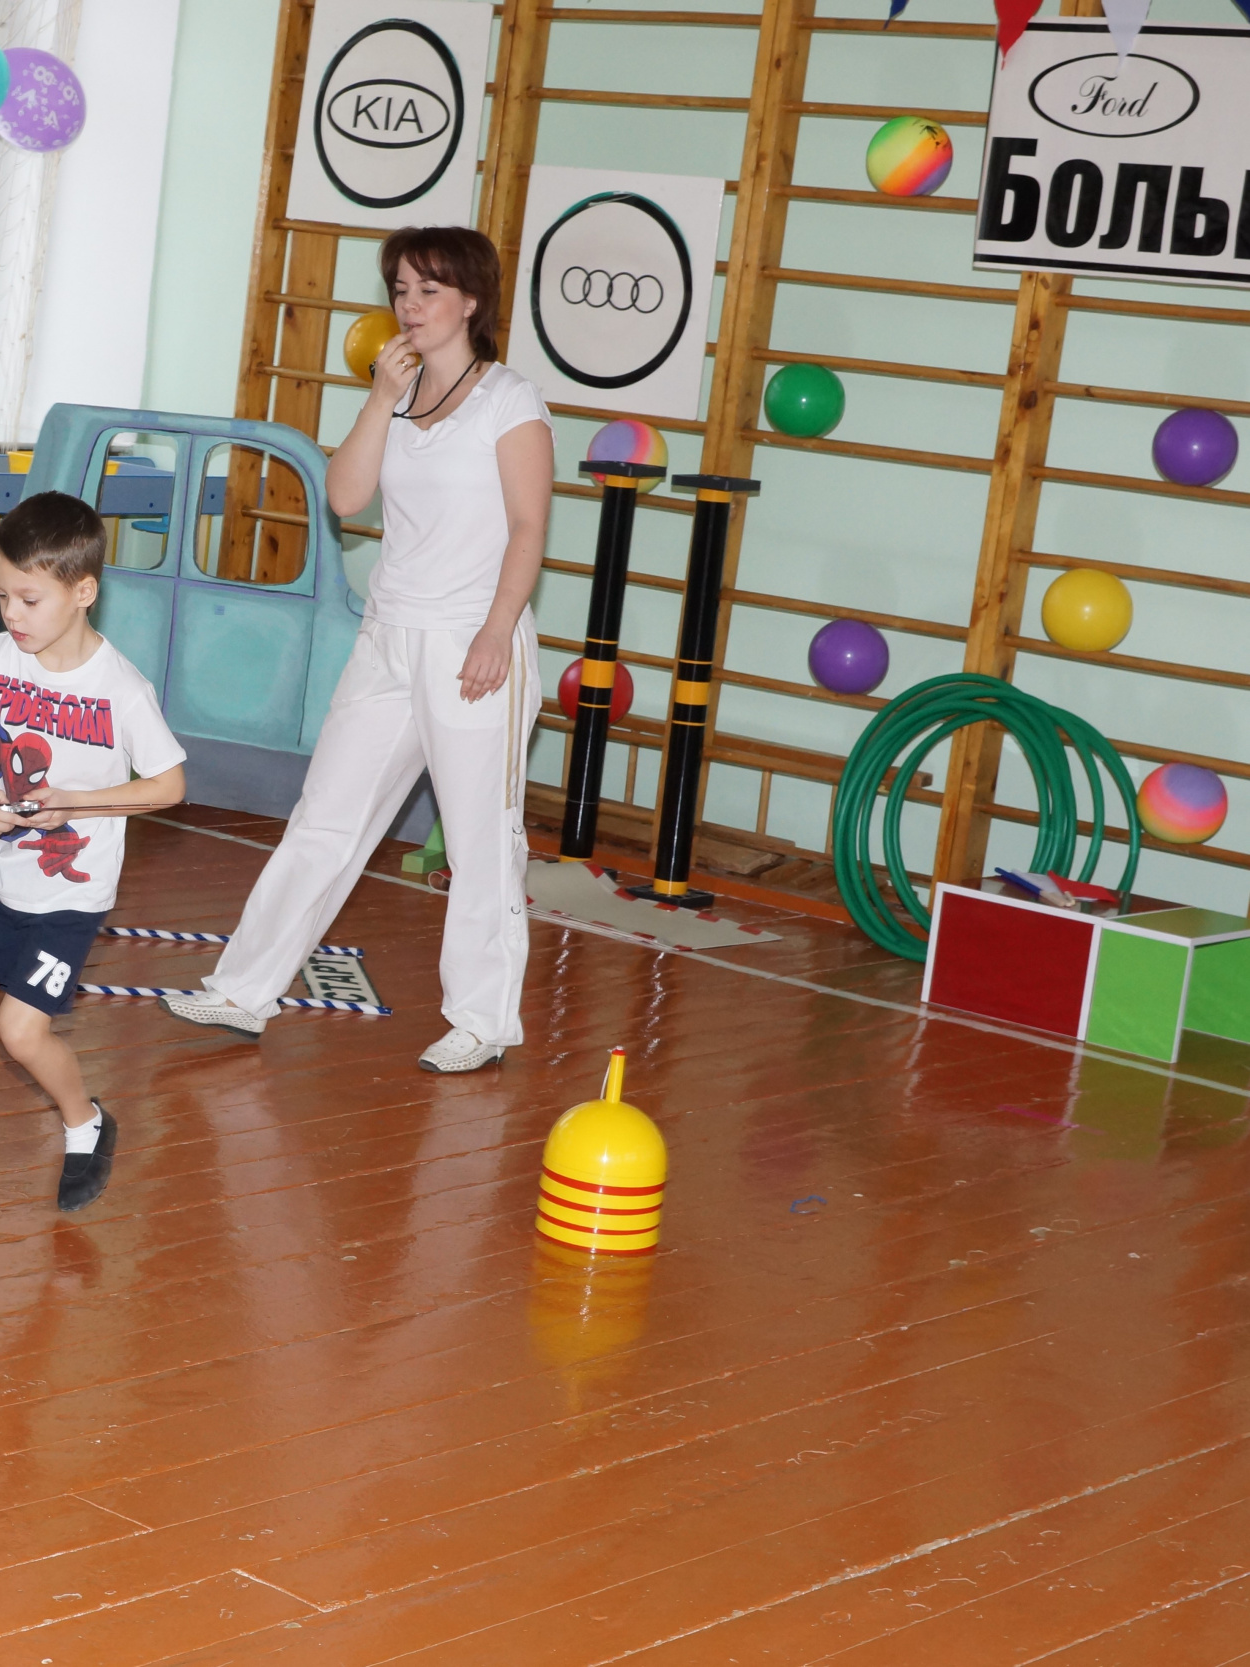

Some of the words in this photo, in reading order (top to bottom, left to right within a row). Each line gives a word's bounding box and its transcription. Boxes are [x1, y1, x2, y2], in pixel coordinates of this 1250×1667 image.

[352, 95, 424, 133] KIA
[1071, 74, 1159, 118] Ford
[27, 950, 72, 998] 78
[308, 956, 368, 1003] СТАРТ
